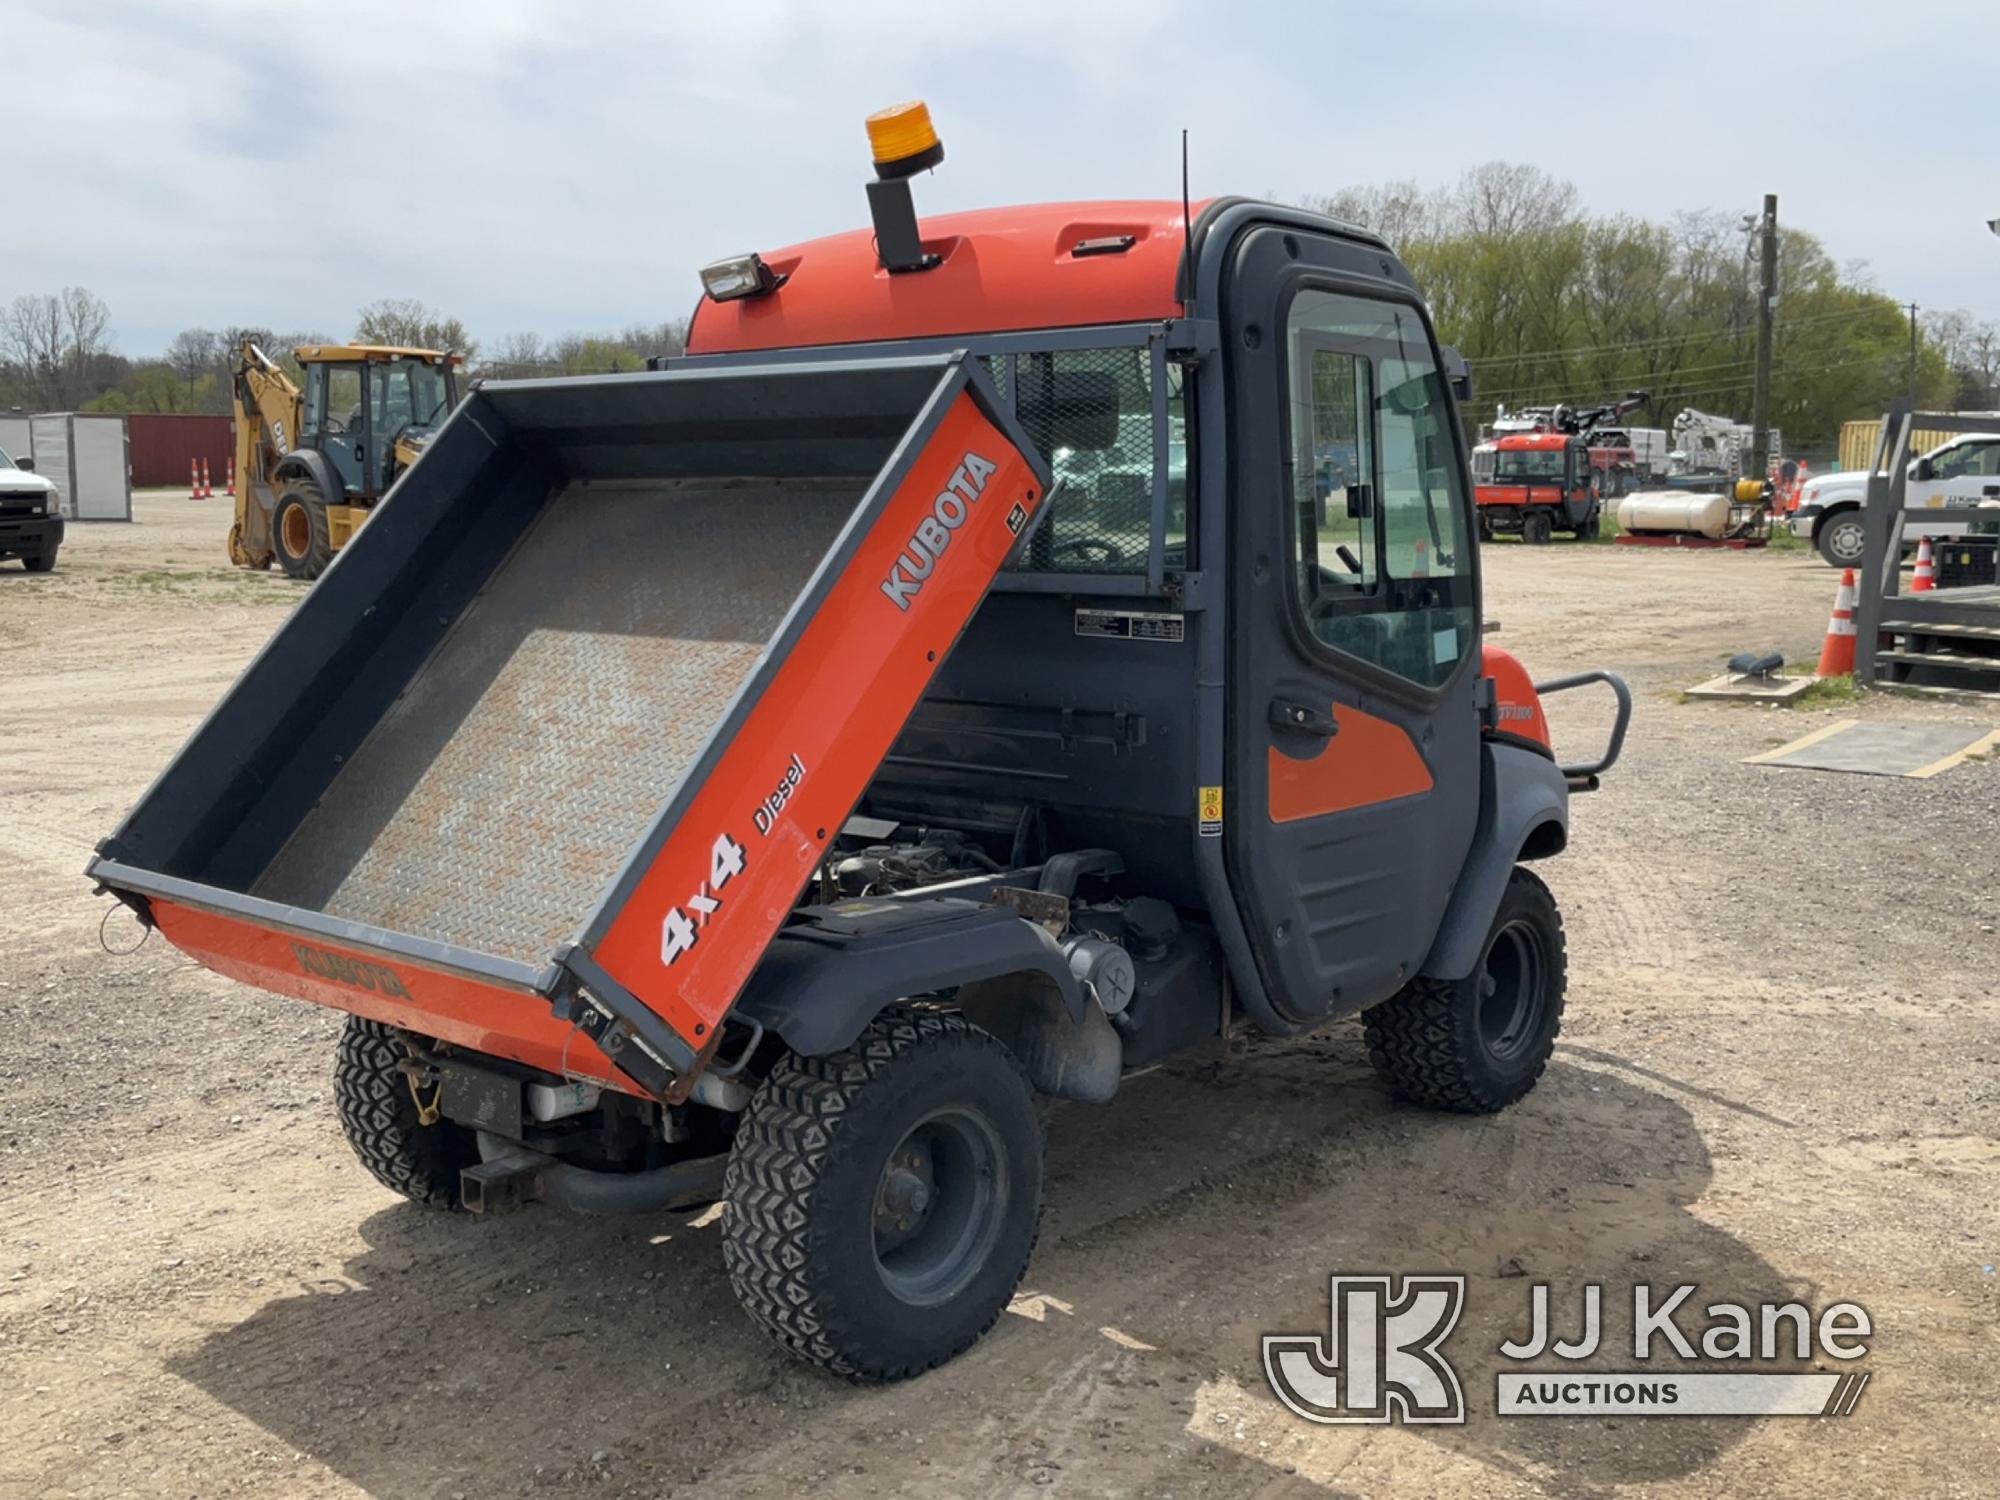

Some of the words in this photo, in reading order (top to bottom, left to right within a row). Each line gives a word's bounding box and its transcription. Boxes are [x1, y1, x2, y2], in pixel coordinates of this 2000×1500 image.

[880, 451, 998, 613] KUBOTA
[753, 752, 807, 836] Diesel
[660, 832, 748, 967] 4x4
[290, 942, 413, 1001] KUBOTA
